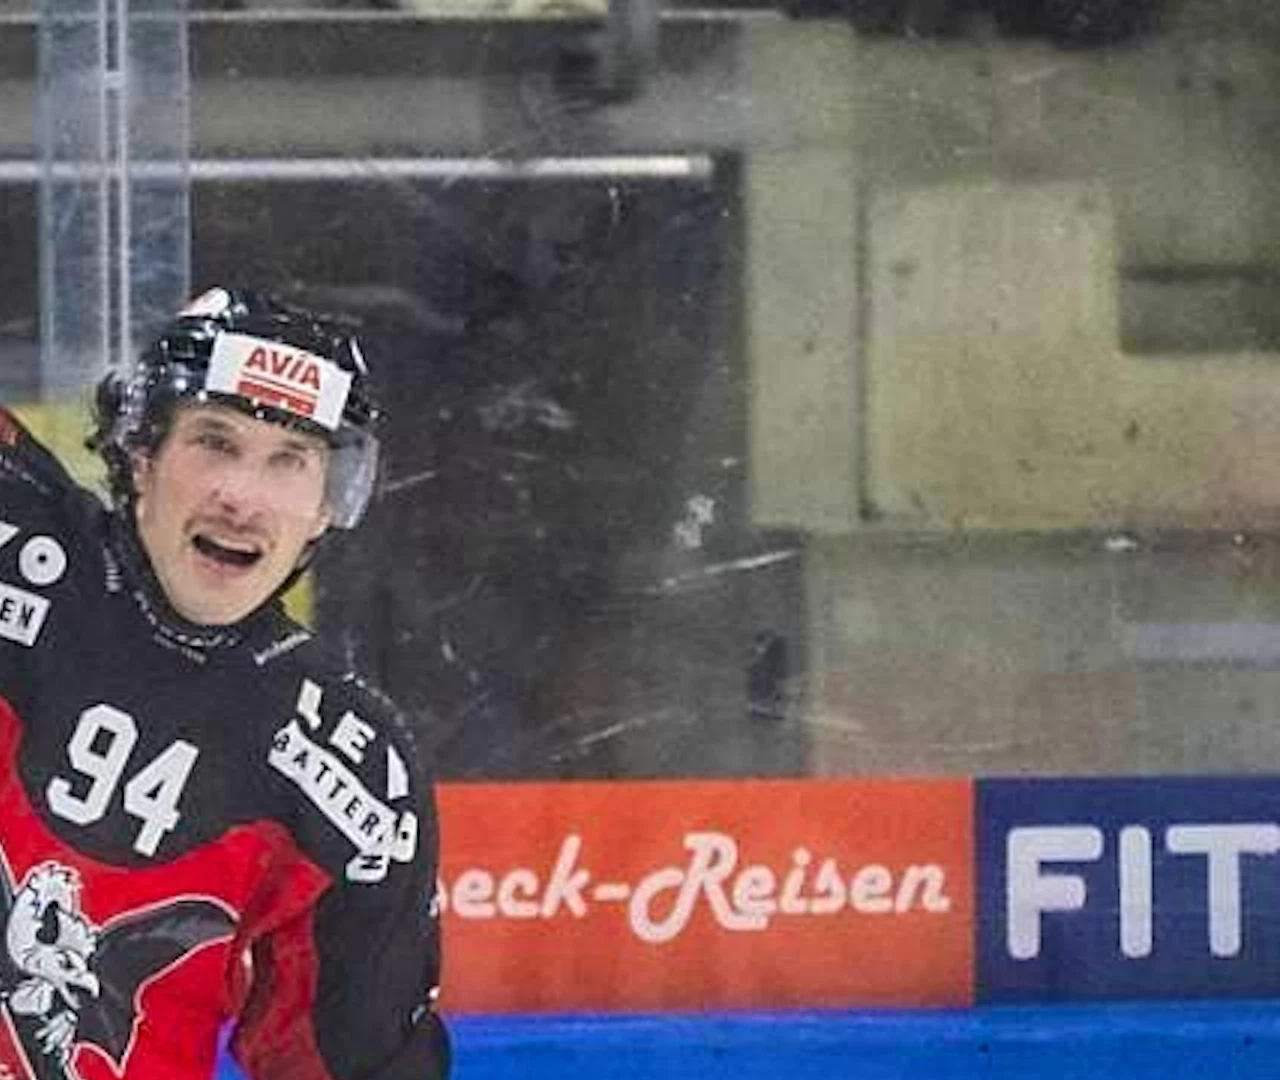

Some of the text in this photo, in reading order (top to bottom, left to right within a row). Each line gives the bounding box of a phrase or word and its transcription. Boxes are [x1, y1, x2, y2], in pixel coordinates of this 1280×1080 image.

[244, 345, 321, 390] AVIA
[46, 703, 200, 858] 94
[1005, 823, 1280, 960] FIT
